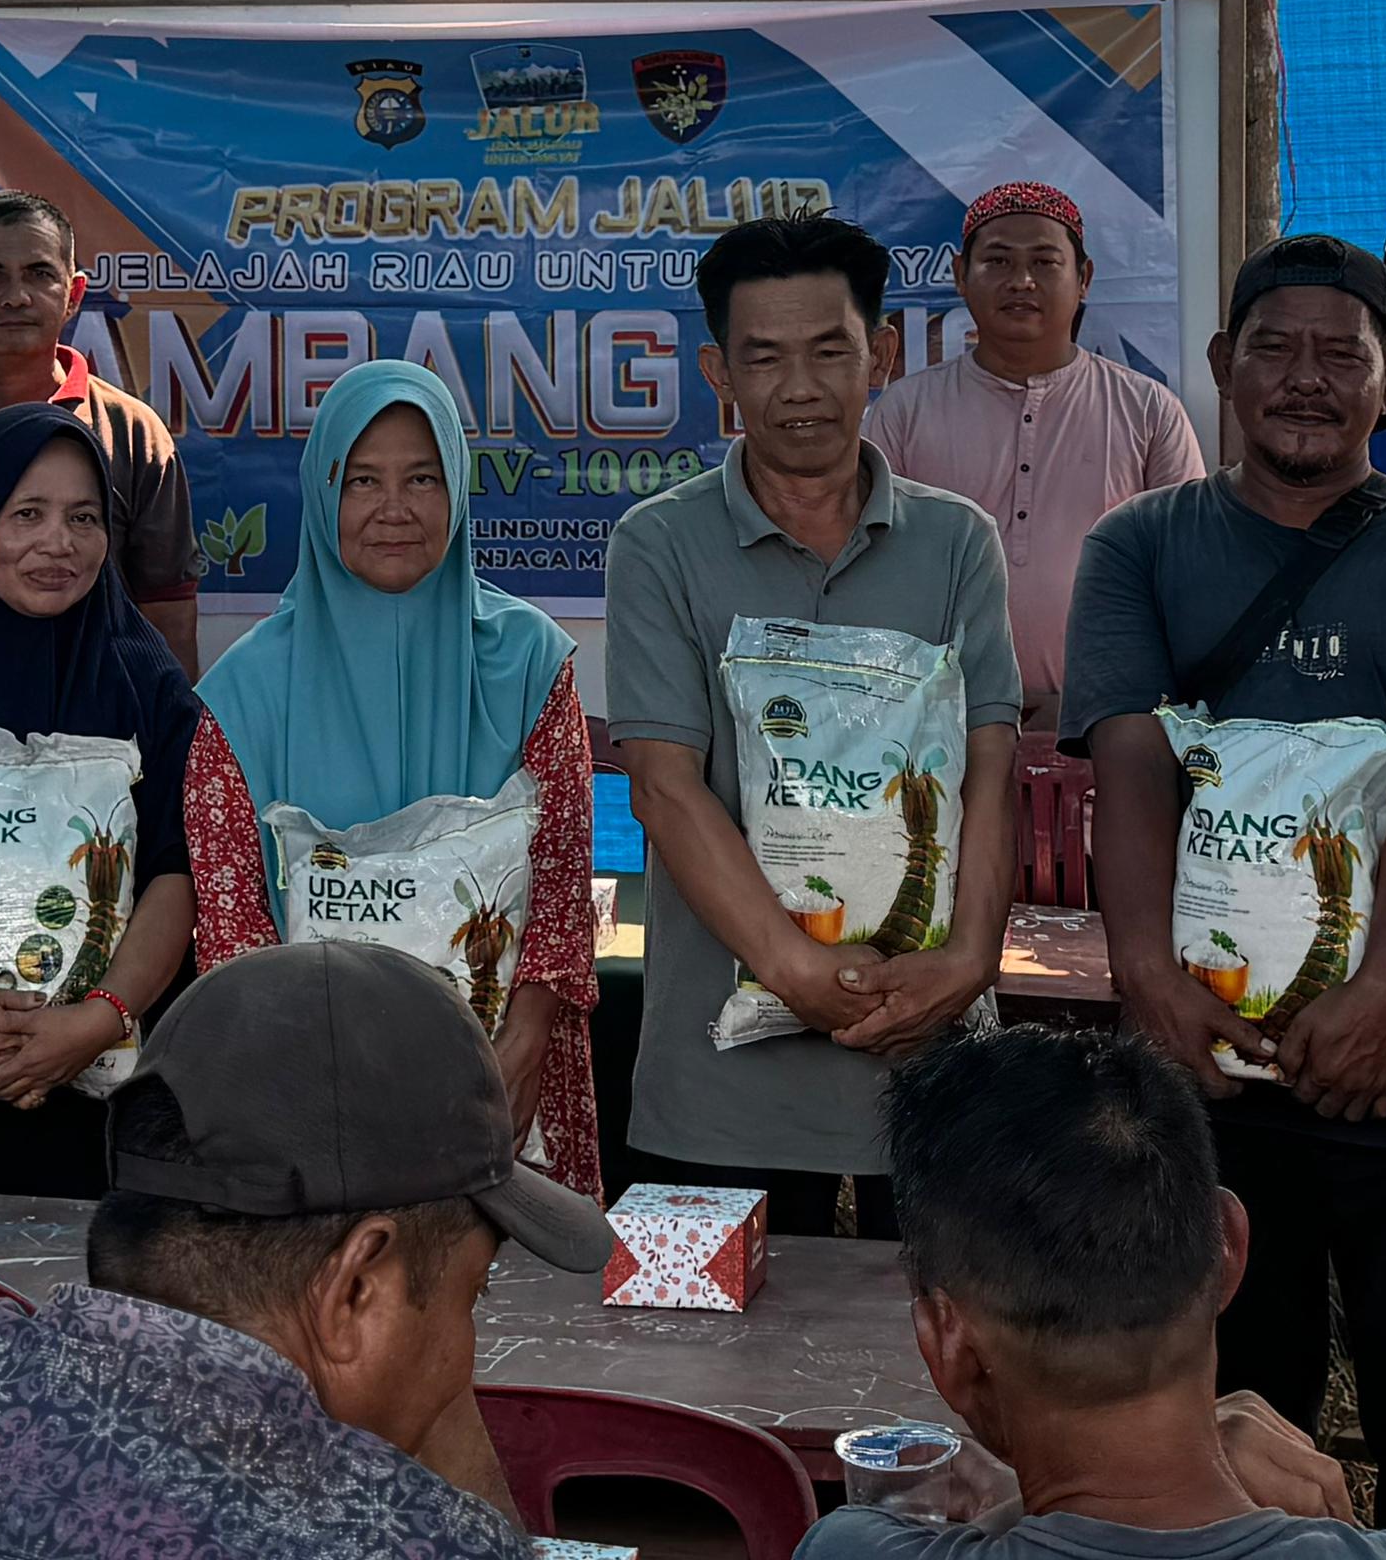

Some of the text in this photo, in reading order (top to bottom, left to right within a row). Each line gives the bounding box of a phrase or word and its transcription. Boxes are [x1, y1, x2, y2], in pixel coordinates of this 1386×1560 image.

[463, 101, 600, 140] JALUR
[226, 176, 578, 243] PROGRAM
[84, 251, 700, 292] JELAJAH RIAU UNTU
[65, 308, 683, 438] AMBANG
[470, 518, 609, 540] LINDUNGI
[470, 547, 570, 570] NJAGA
[1266, 629, 1341, 660] ENZO
[764, 780, 871, 811] KETAK
[1186, 830, 1280, 865] KETAK
[308, 875, 417, 900] UDANG
[308, 897, 402, 923] KETAK
